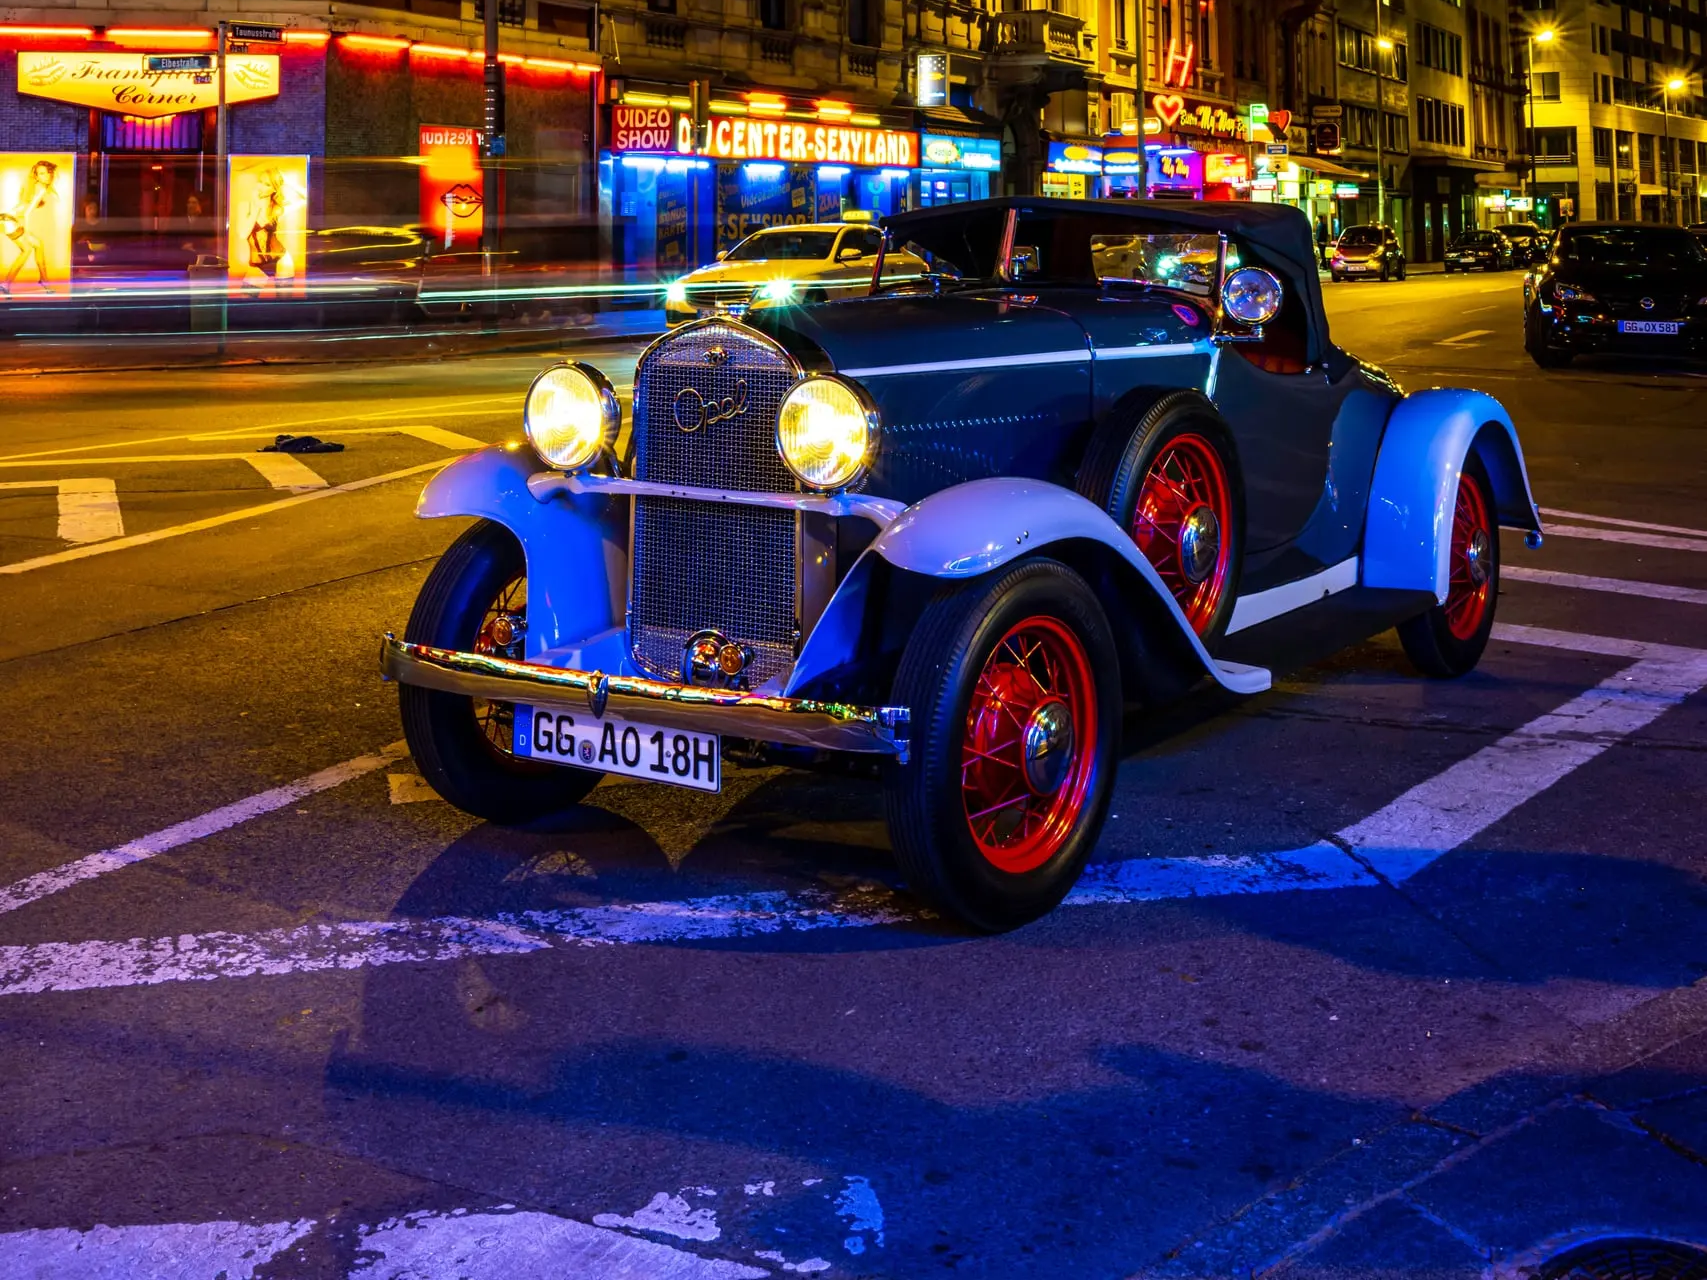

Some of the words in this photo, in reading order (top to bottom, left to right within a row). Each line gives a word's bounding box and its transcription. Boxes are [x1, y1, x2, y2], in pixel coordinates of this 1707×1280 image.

[235, 27, 280, 39] Taunusstraße
[161, 57, 199, 69] Elbestraße
[112, 85, 197, 104] Corner
[616, 108, 671, 128] VIDEO
[616, 129, 671, 150] SHOW
[715, 120, 911, 166] CENTER-SEXYLAND
[673, 378, 750, 434] Opel
[519, 734, 527, 746] D
[533, 711, 575, 757] GG
[598, 722, 641, 768] AO
[650, 730, 715, 783] 18H
